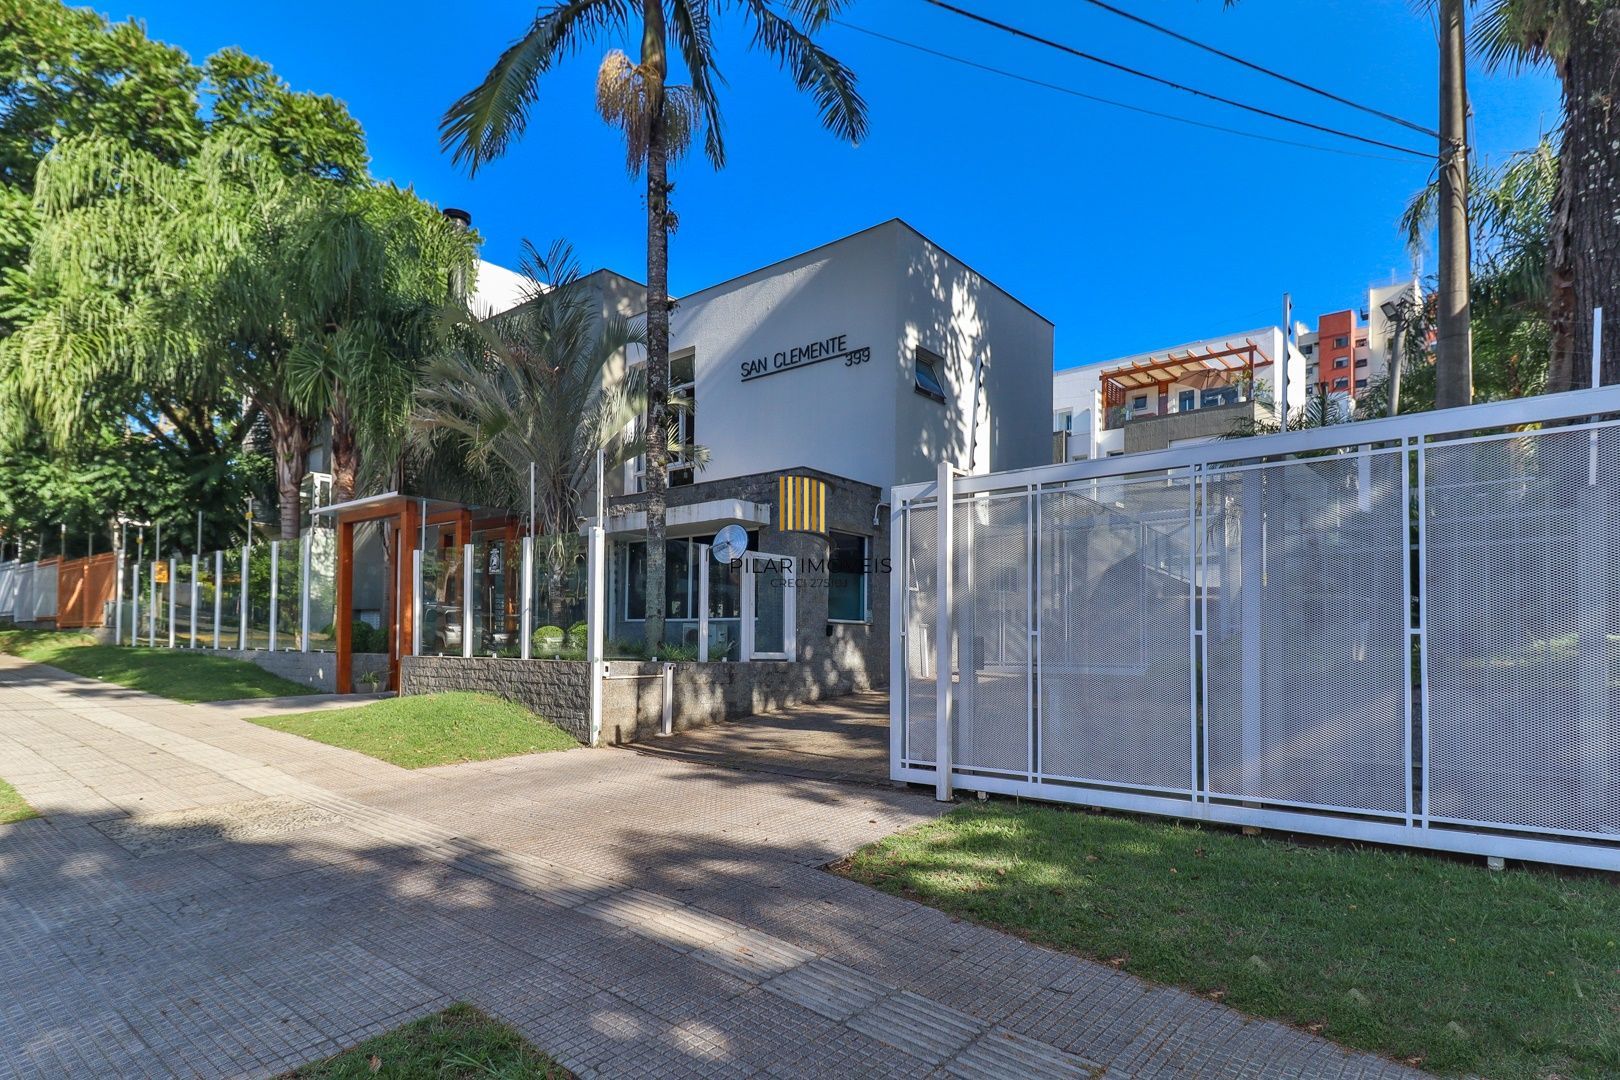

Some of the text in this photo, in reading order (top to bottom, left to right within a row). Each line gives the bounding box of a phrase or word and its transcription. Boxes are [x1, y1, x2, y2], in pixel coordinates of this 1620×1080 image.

[741, 334, 847, 377] SAN CLEMENTE
[845, 348, 870, 367] 399
